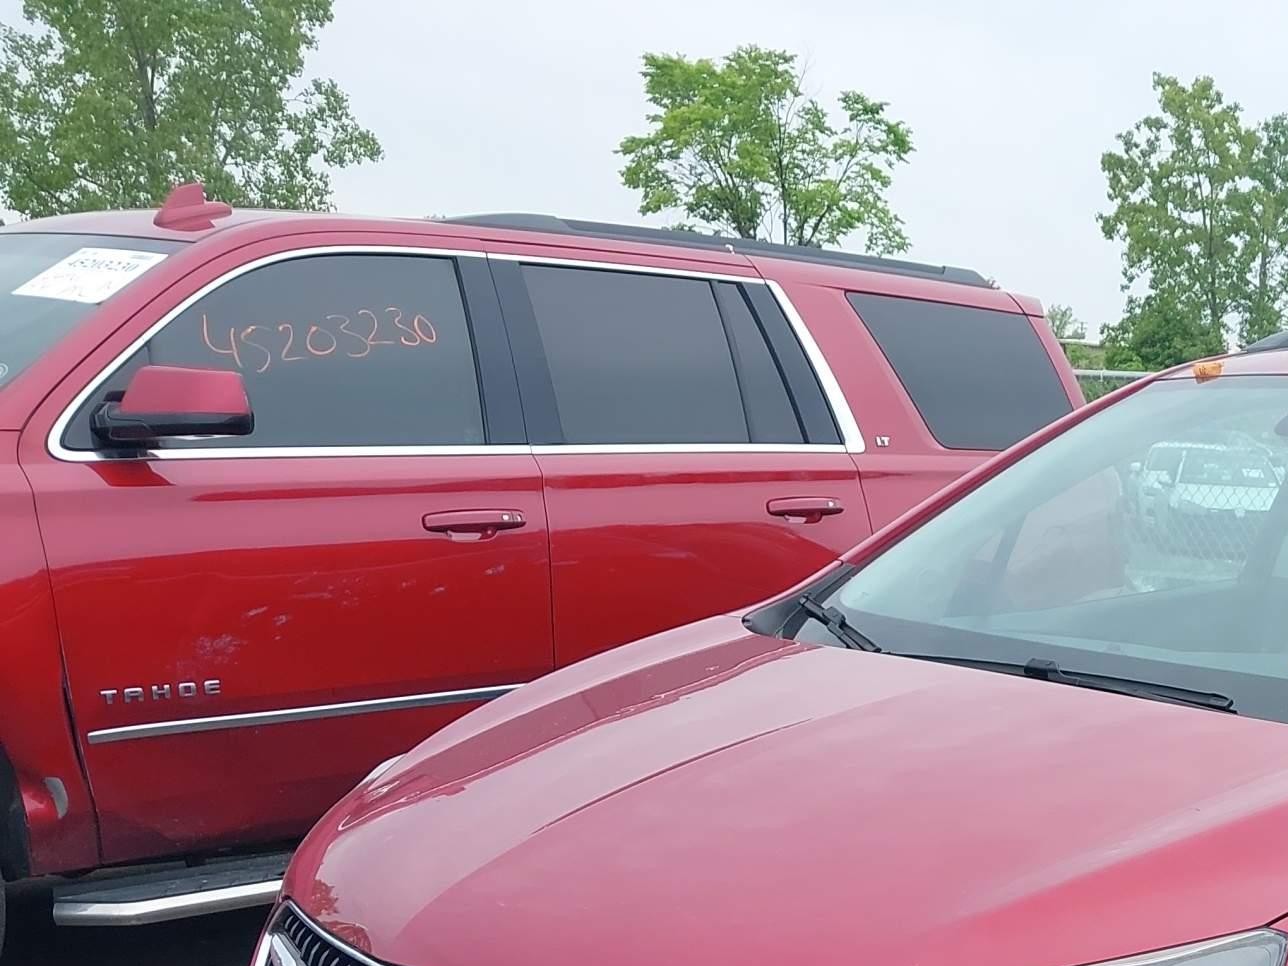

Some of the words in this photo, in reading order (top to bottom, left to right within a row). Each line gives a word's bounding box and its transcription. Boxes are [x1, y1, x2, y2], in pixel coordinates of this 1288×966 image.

[202, 306, 437, 374] 45203230
[875, 436, 891, 447] LT
[99, 679, 222, 705] TAHOE
